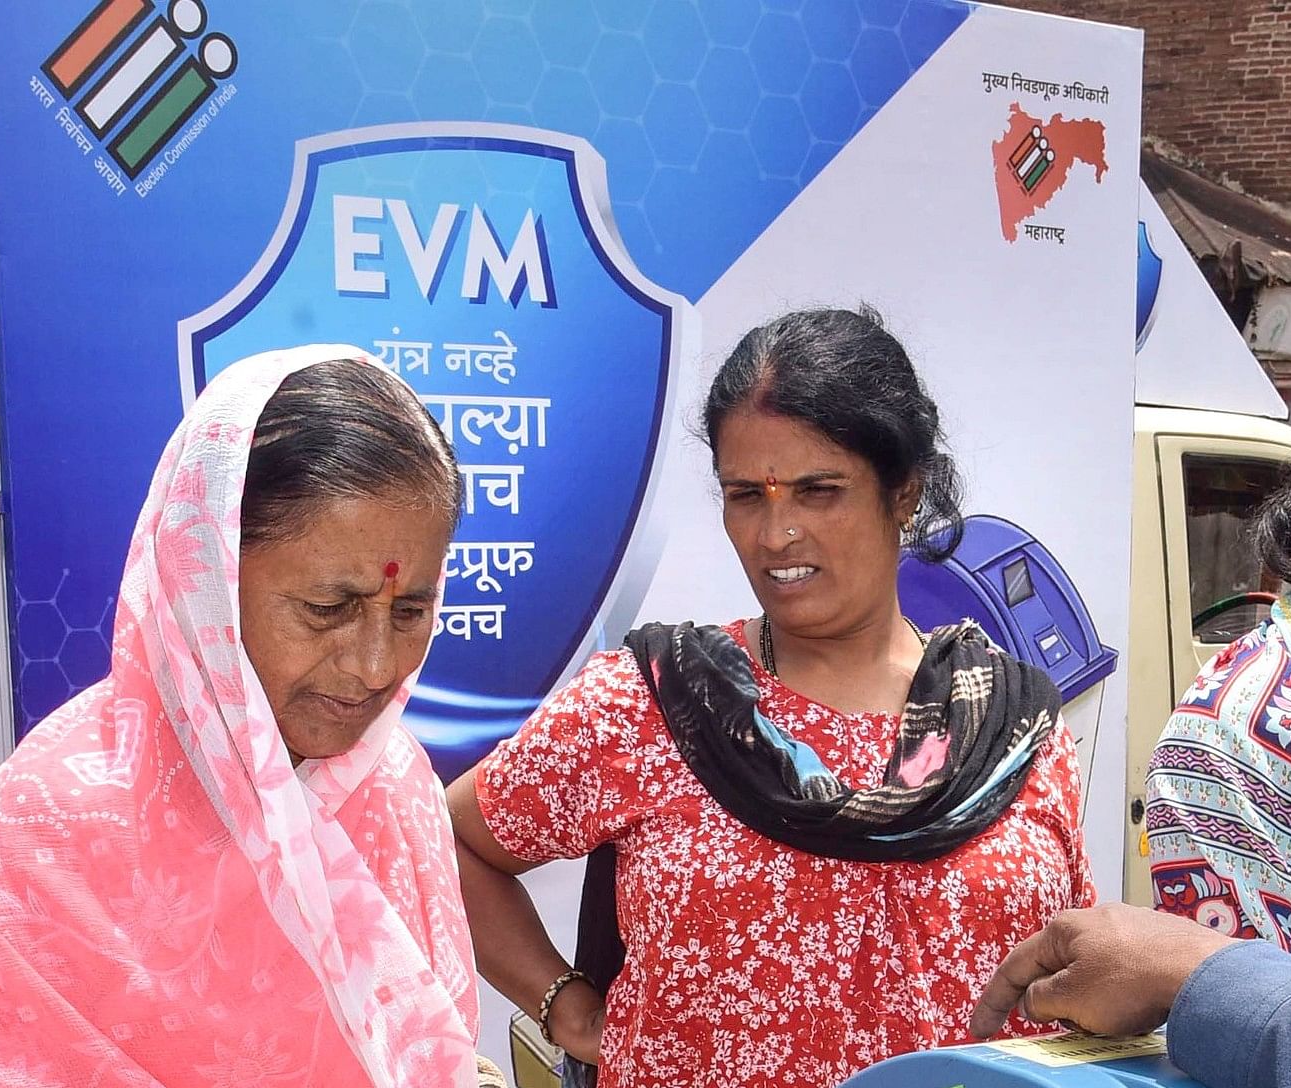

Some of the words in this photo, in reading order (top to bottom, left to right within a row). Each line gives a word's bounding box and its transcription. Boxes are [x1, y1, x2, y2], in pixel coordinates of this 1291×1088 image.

[982, 72, 1009, 93] मुख्य
[1011, 72, 1060, 102] निवडणूक
[1061, 81, 1110, 105] अधिकारी
[29, 75, 55, 109] भारत
[93, 156, 127, 197] आयोग
[134, 162, 168, 198] Election
[164, 114, 210, 165] Commission
[207, 101, 218, 117] of
[214, 83, 238, 109] India
[331, 194, 555, 308] EVM
[1024, 224, 1065, 244] महाराष्ट्र
[374, 327, 431, 376] यंत्र
[442, 330, 518, 385] नव्हे
